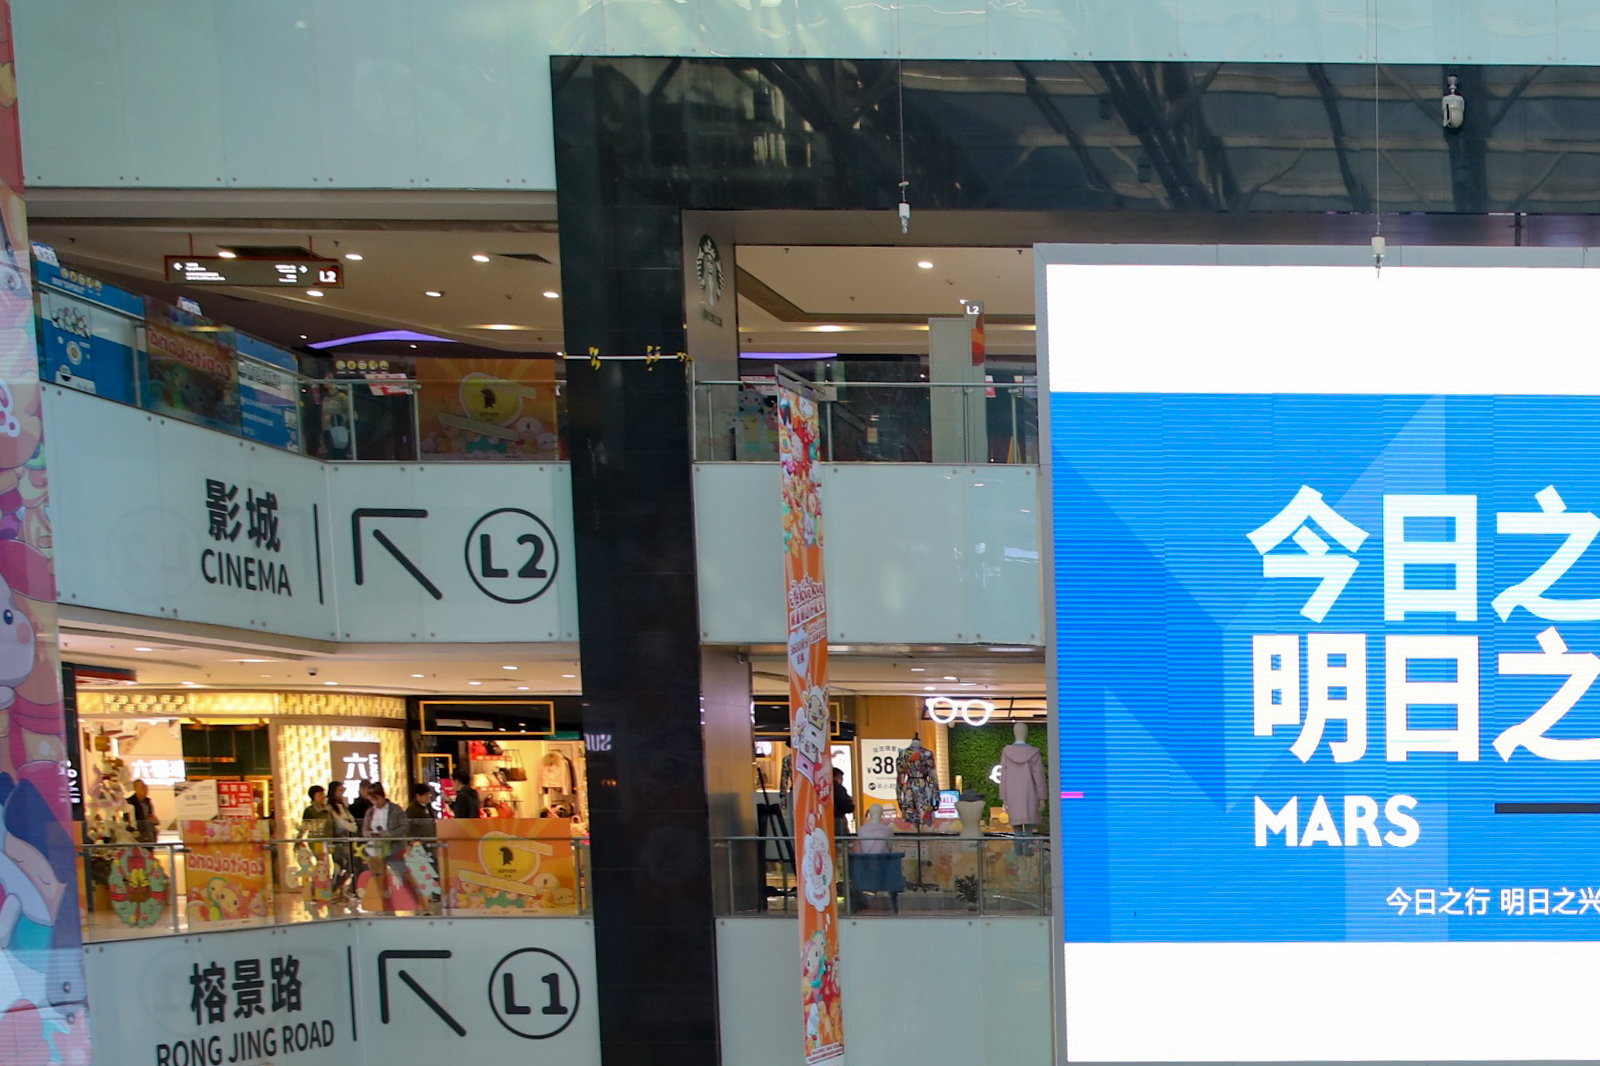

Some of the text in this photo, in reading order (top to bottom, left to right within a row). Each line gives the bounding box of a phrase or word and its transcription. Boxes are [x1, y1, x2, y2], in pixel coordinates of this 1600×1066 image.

[205, 477, 281, 553] 影城
[201, 548, 293, 597] CINEMA
[480, 533, 548, 579] L2
[1253, 794, 1420, 849] MARS
[1386, 887, 1491, 917] 今日之行
[189, 953, 304, 1026] 榕景路
[503, 972, 569, 1015] L1
[228, 1026, 278, 1063] JING
[282, 1019, 335, 1055] ROAD
